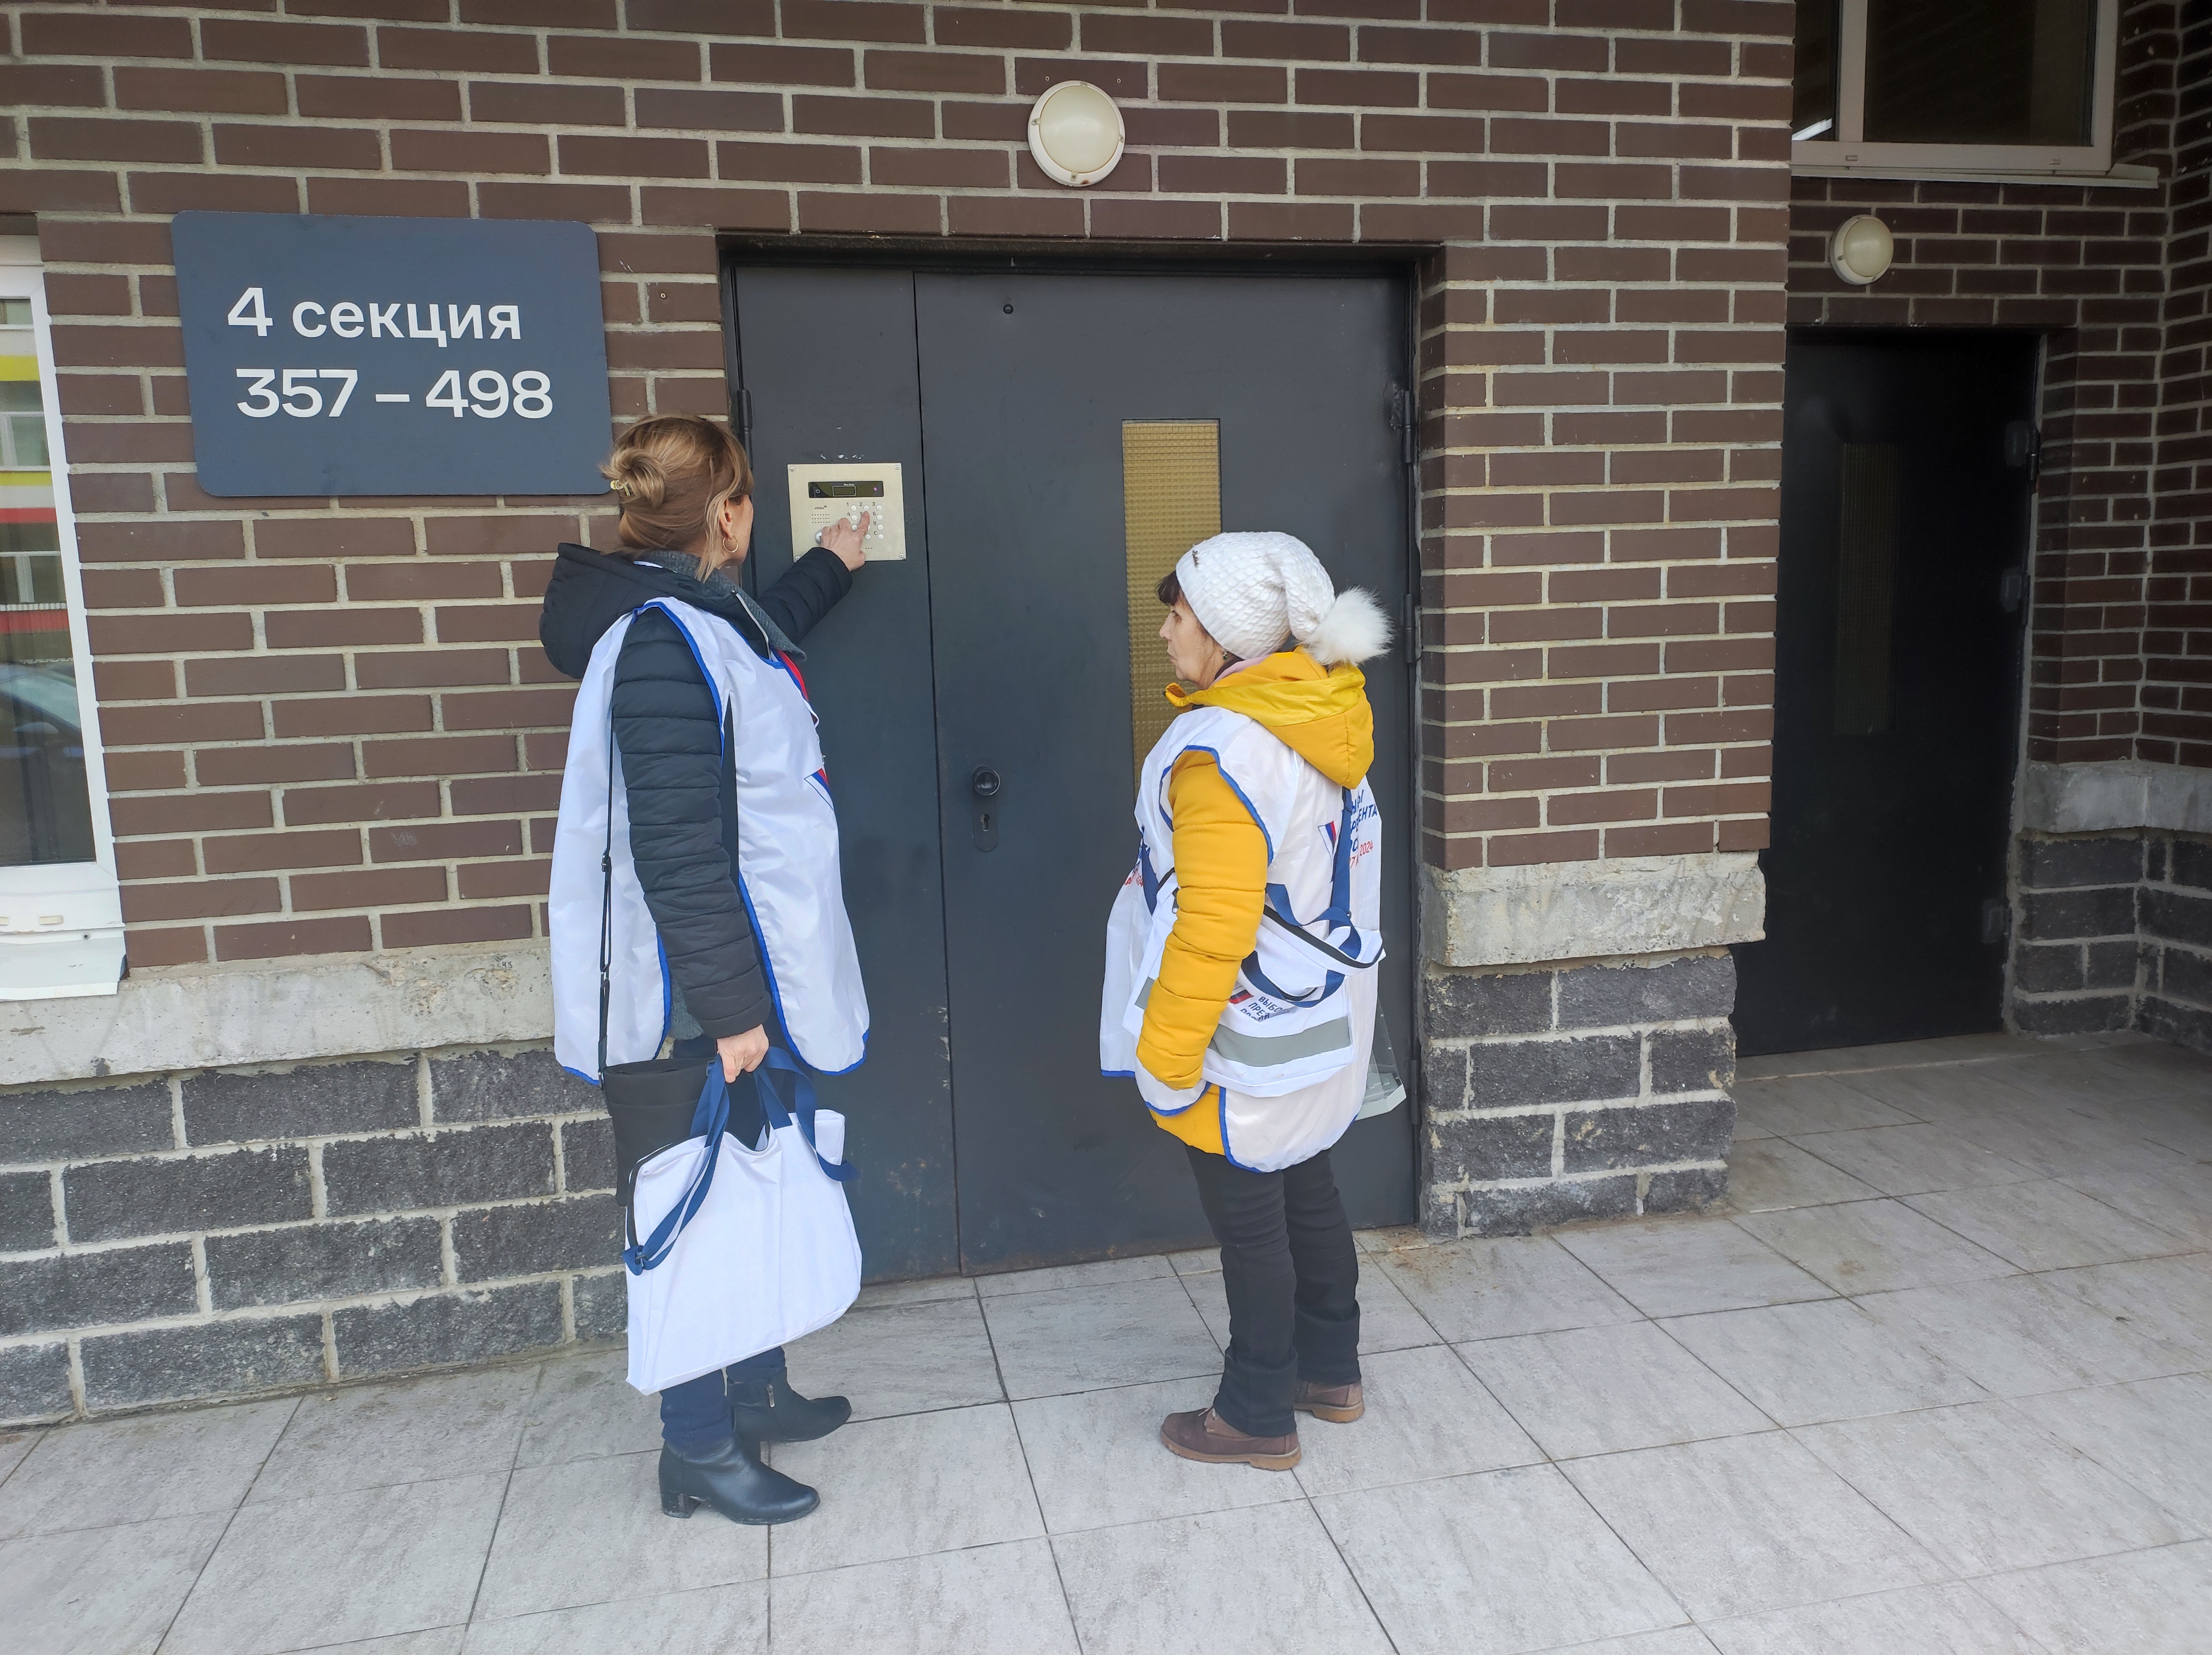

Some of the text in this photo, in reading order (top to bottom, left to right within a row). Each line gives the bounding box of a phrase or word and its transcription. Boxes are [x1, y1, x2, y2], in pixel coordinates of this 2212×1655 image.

[227, 287, 522, 348] 4 секция
[236, 368, 358, 418] 357
[425, 369, 553, 419] 498
[1360, 839, 1373, 857] 2024
[1258, 996, 1283, 1012] ВЫБО
